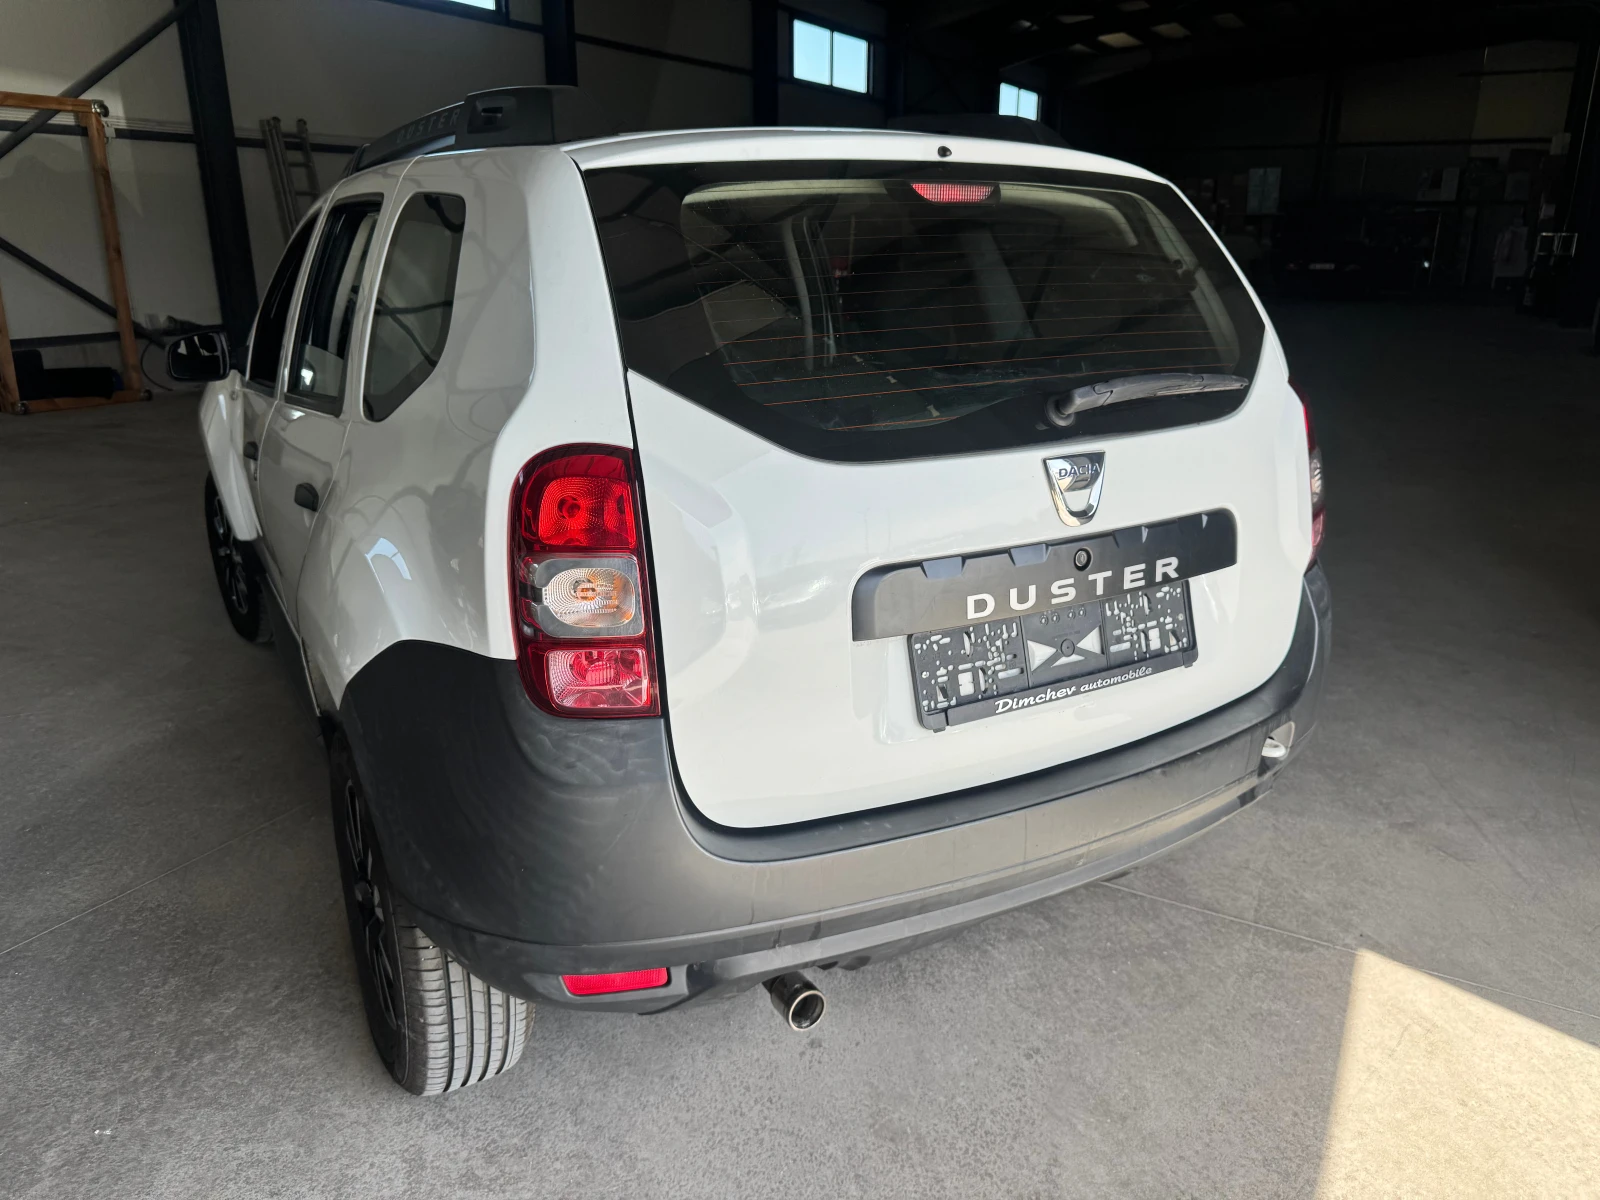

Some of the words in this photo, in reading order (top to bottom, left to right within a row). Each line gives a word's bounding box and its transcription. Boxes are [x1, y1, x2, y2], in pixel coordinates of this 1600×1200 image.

[396, 108, 461, 144] DUSTER
[1058, 462, 1101, 478] DACIA
[966, 556, 1180, 620] DUSTER
[994, 684, 1077, 714] Dimchev
[1080, 665, 1153, 693] automobile
